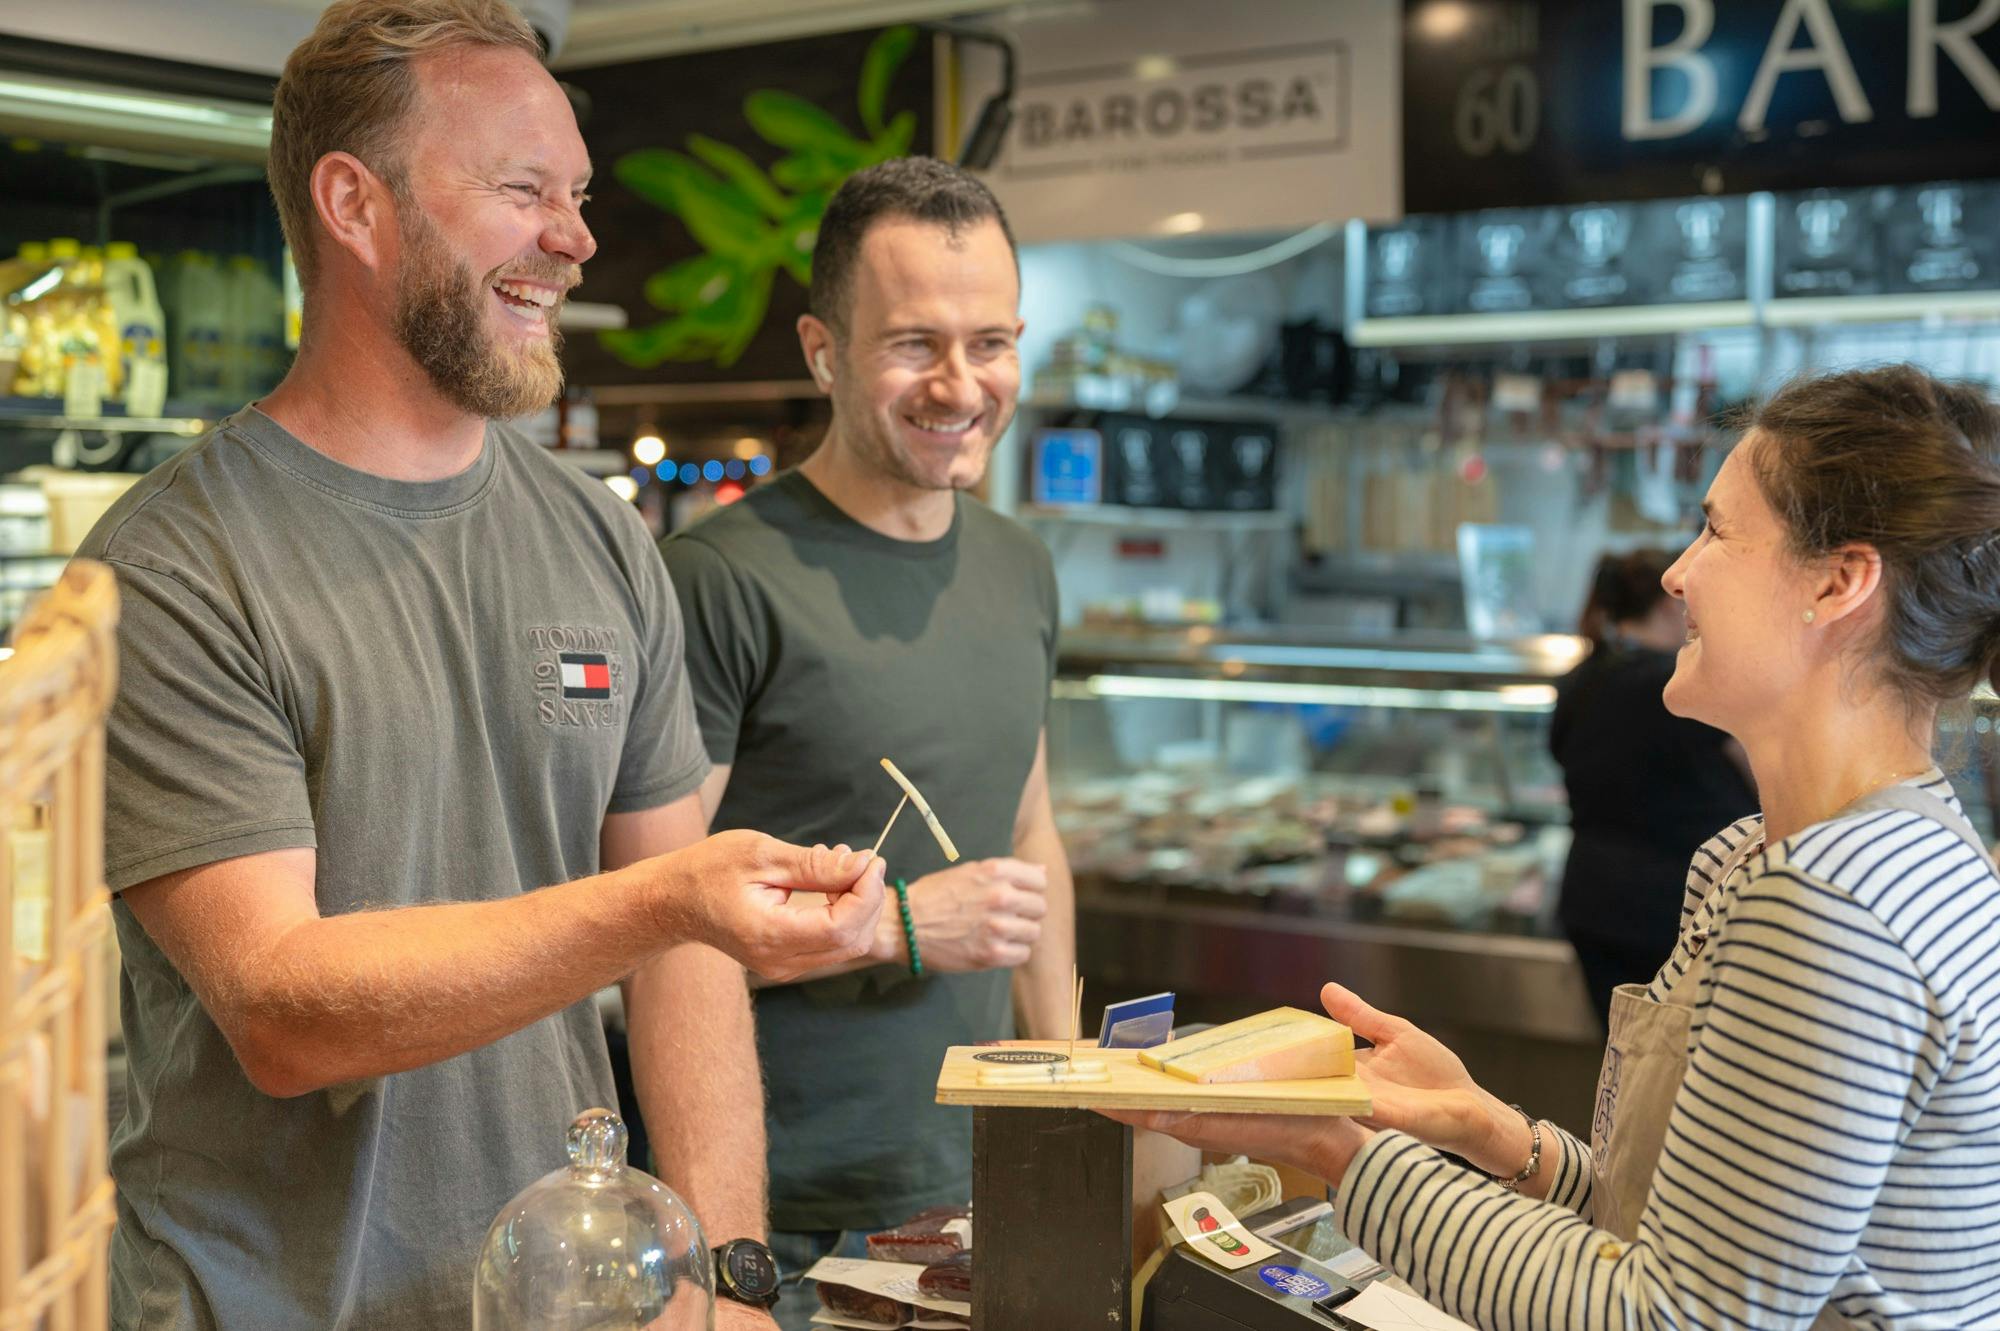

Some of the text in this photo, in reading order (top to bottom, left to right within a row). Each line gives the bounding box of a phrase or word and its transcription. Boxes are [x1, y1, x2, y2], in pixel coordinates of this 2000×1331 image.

[1018, 76, 1321, 148] BAROSSA
[1456, 62, 1540, 157] 60
[1621, 0, 2000, 141] BAR
[529, 627, 619, 653] TOMMY
